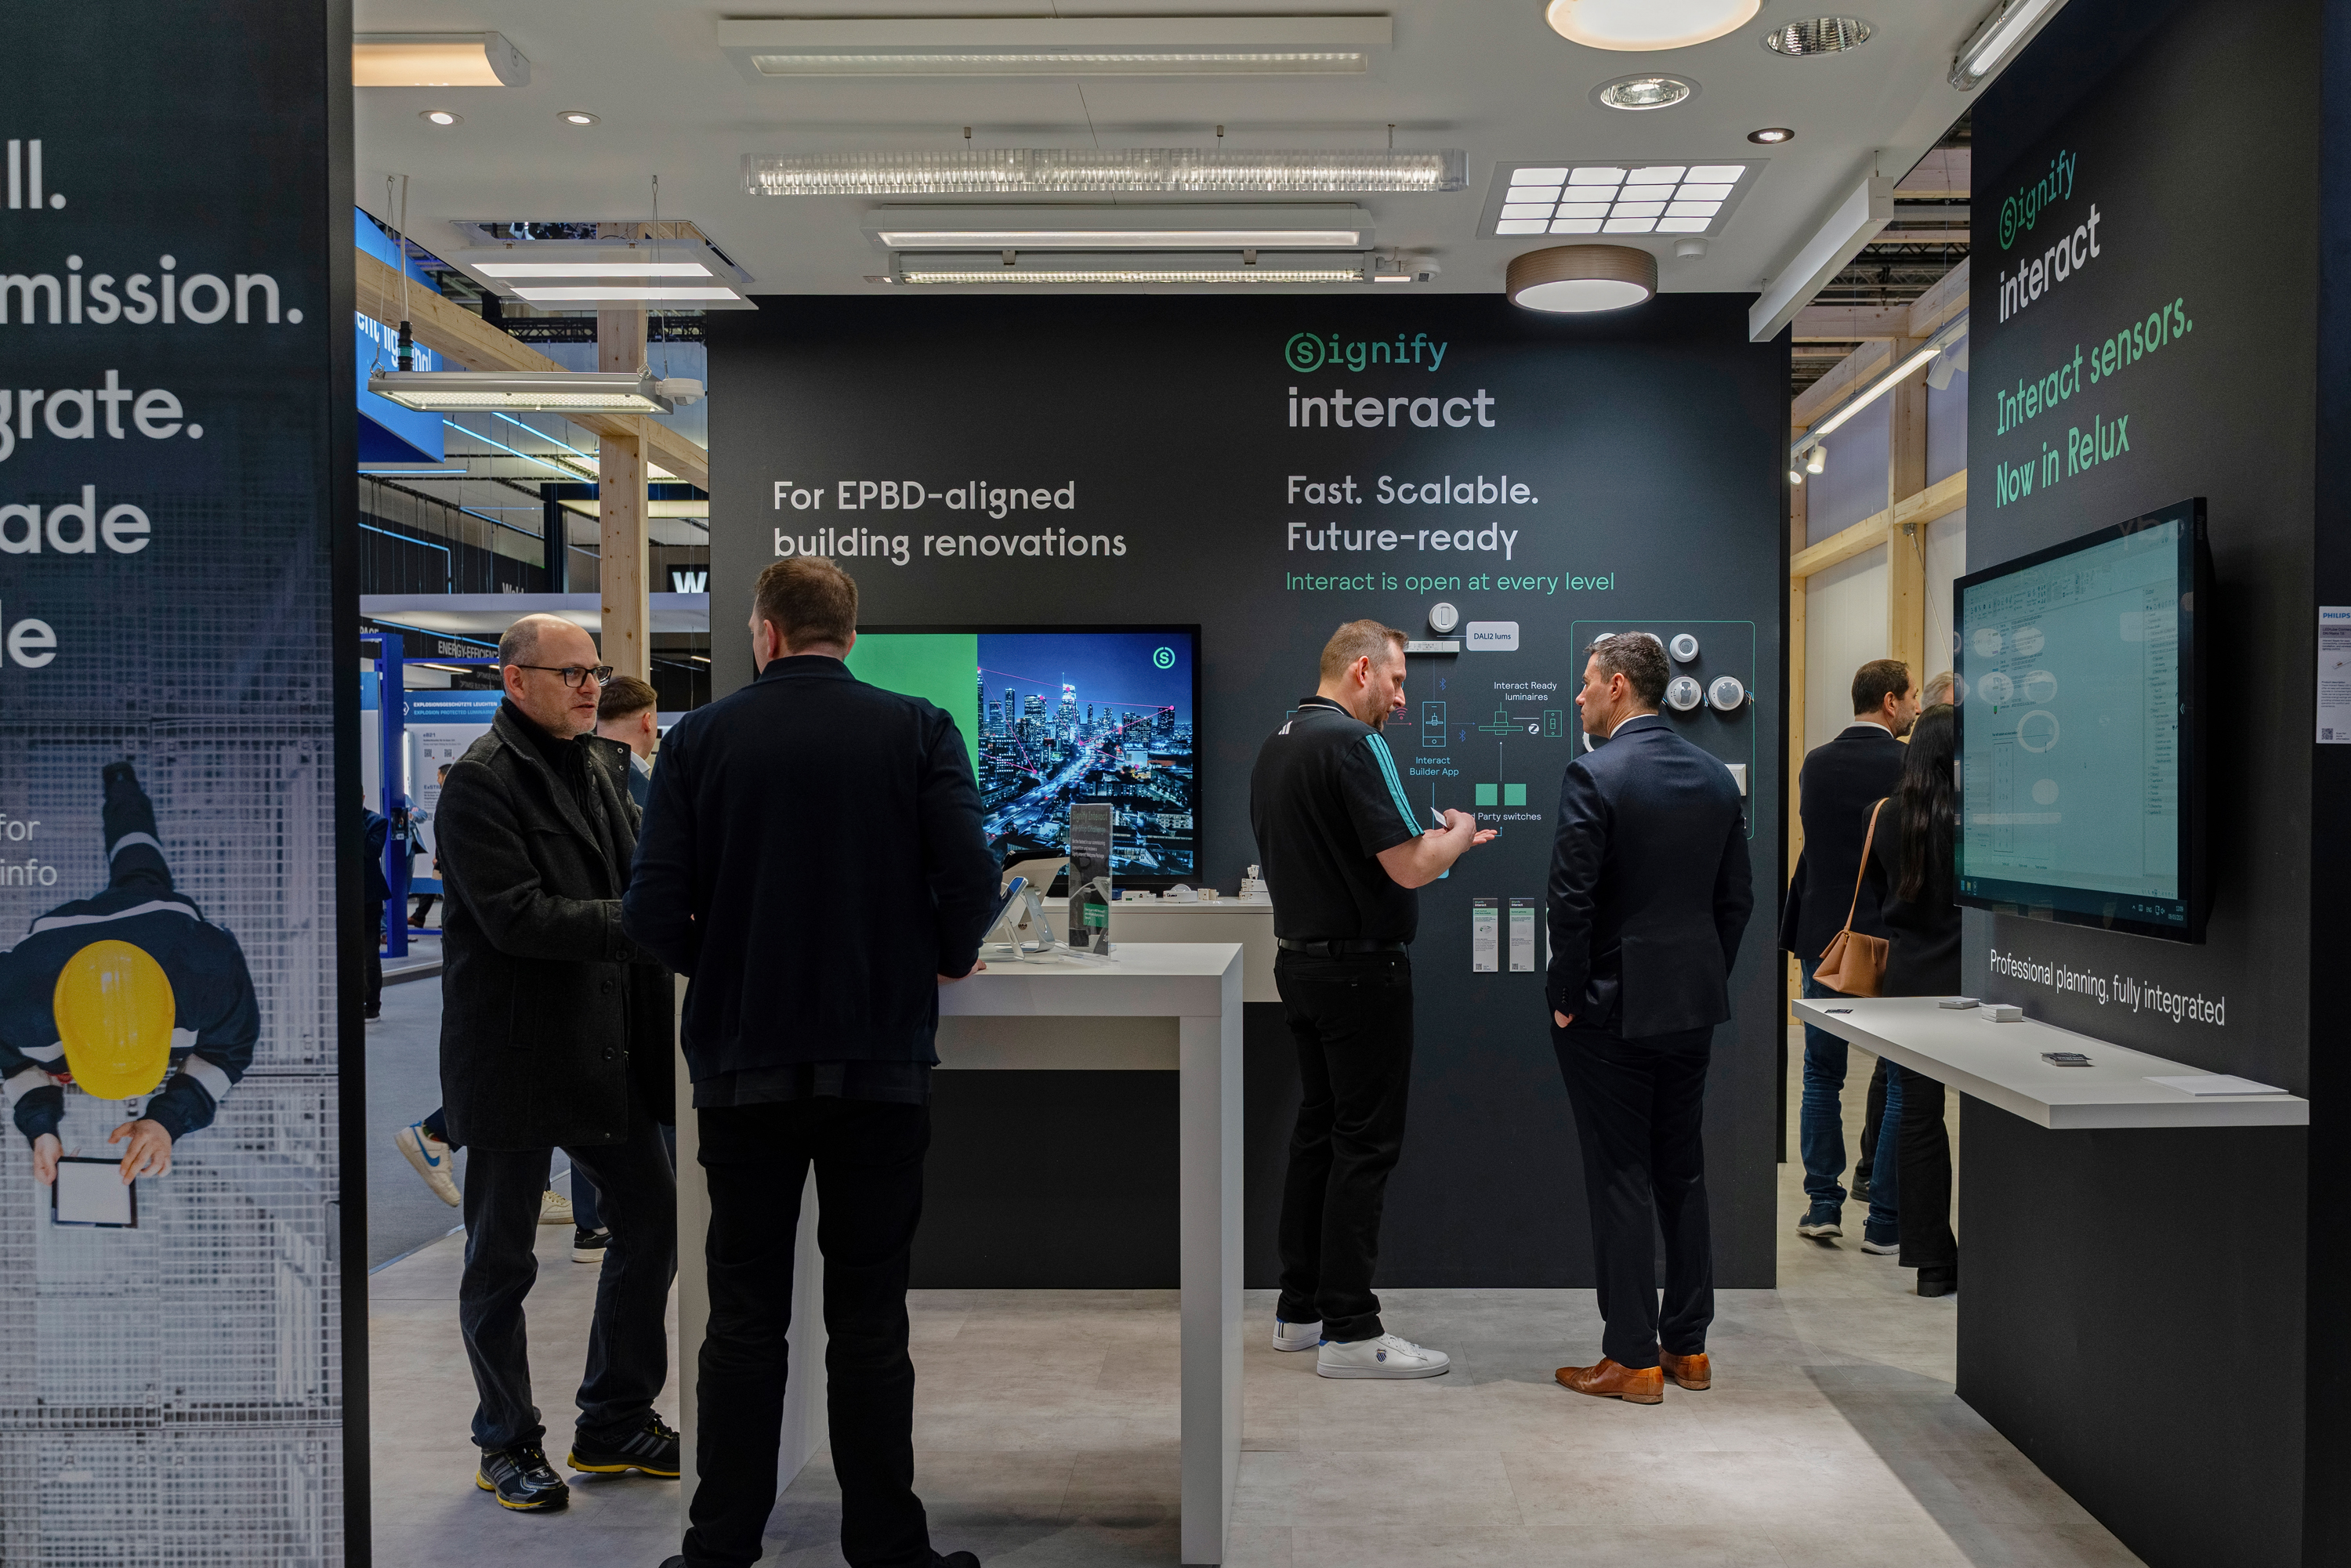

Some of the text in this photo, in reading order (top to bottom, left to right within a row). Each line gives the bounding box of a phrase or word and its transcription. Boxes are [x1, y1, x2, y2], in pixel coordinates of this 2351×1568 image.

[8, 139, 67, 210] ll.
[1999, 203, 2101, 324] interact
[0, 254, 303, 324] mission.
[1997, 297, 2193, 436] Interact sensors.
[1288, 386, 1496, 429] interact
[1996, 414, 2130, 509] Now in Relux
[773, 480, 1074, 520] For EPBD-aligned
[1288, 474, 1539, 505] Fast. Scalable.
[0, 483, 151, 555] ade
[773, 527, 1127, 567] building renovations
[1288, 521, 1519, 561] Future-ready
[1287, 571, 1614, 596] Interact is open at every level
[0, 599, 57, 668] e
[1494, 681, 1557, 692] Interact Ready
[1505, 693, 1549, 701] luminaires
[1410, 767, 1459, 777] Builder App
[1415, 756, 1451, 765] Interact
[1478, 813, 1502, 823] Party
[1503, 812, 1542, 820] switches
[0, 858, 58, 886] info
[1991, 948, 2225, 1026] Professional planning, fully integrated
